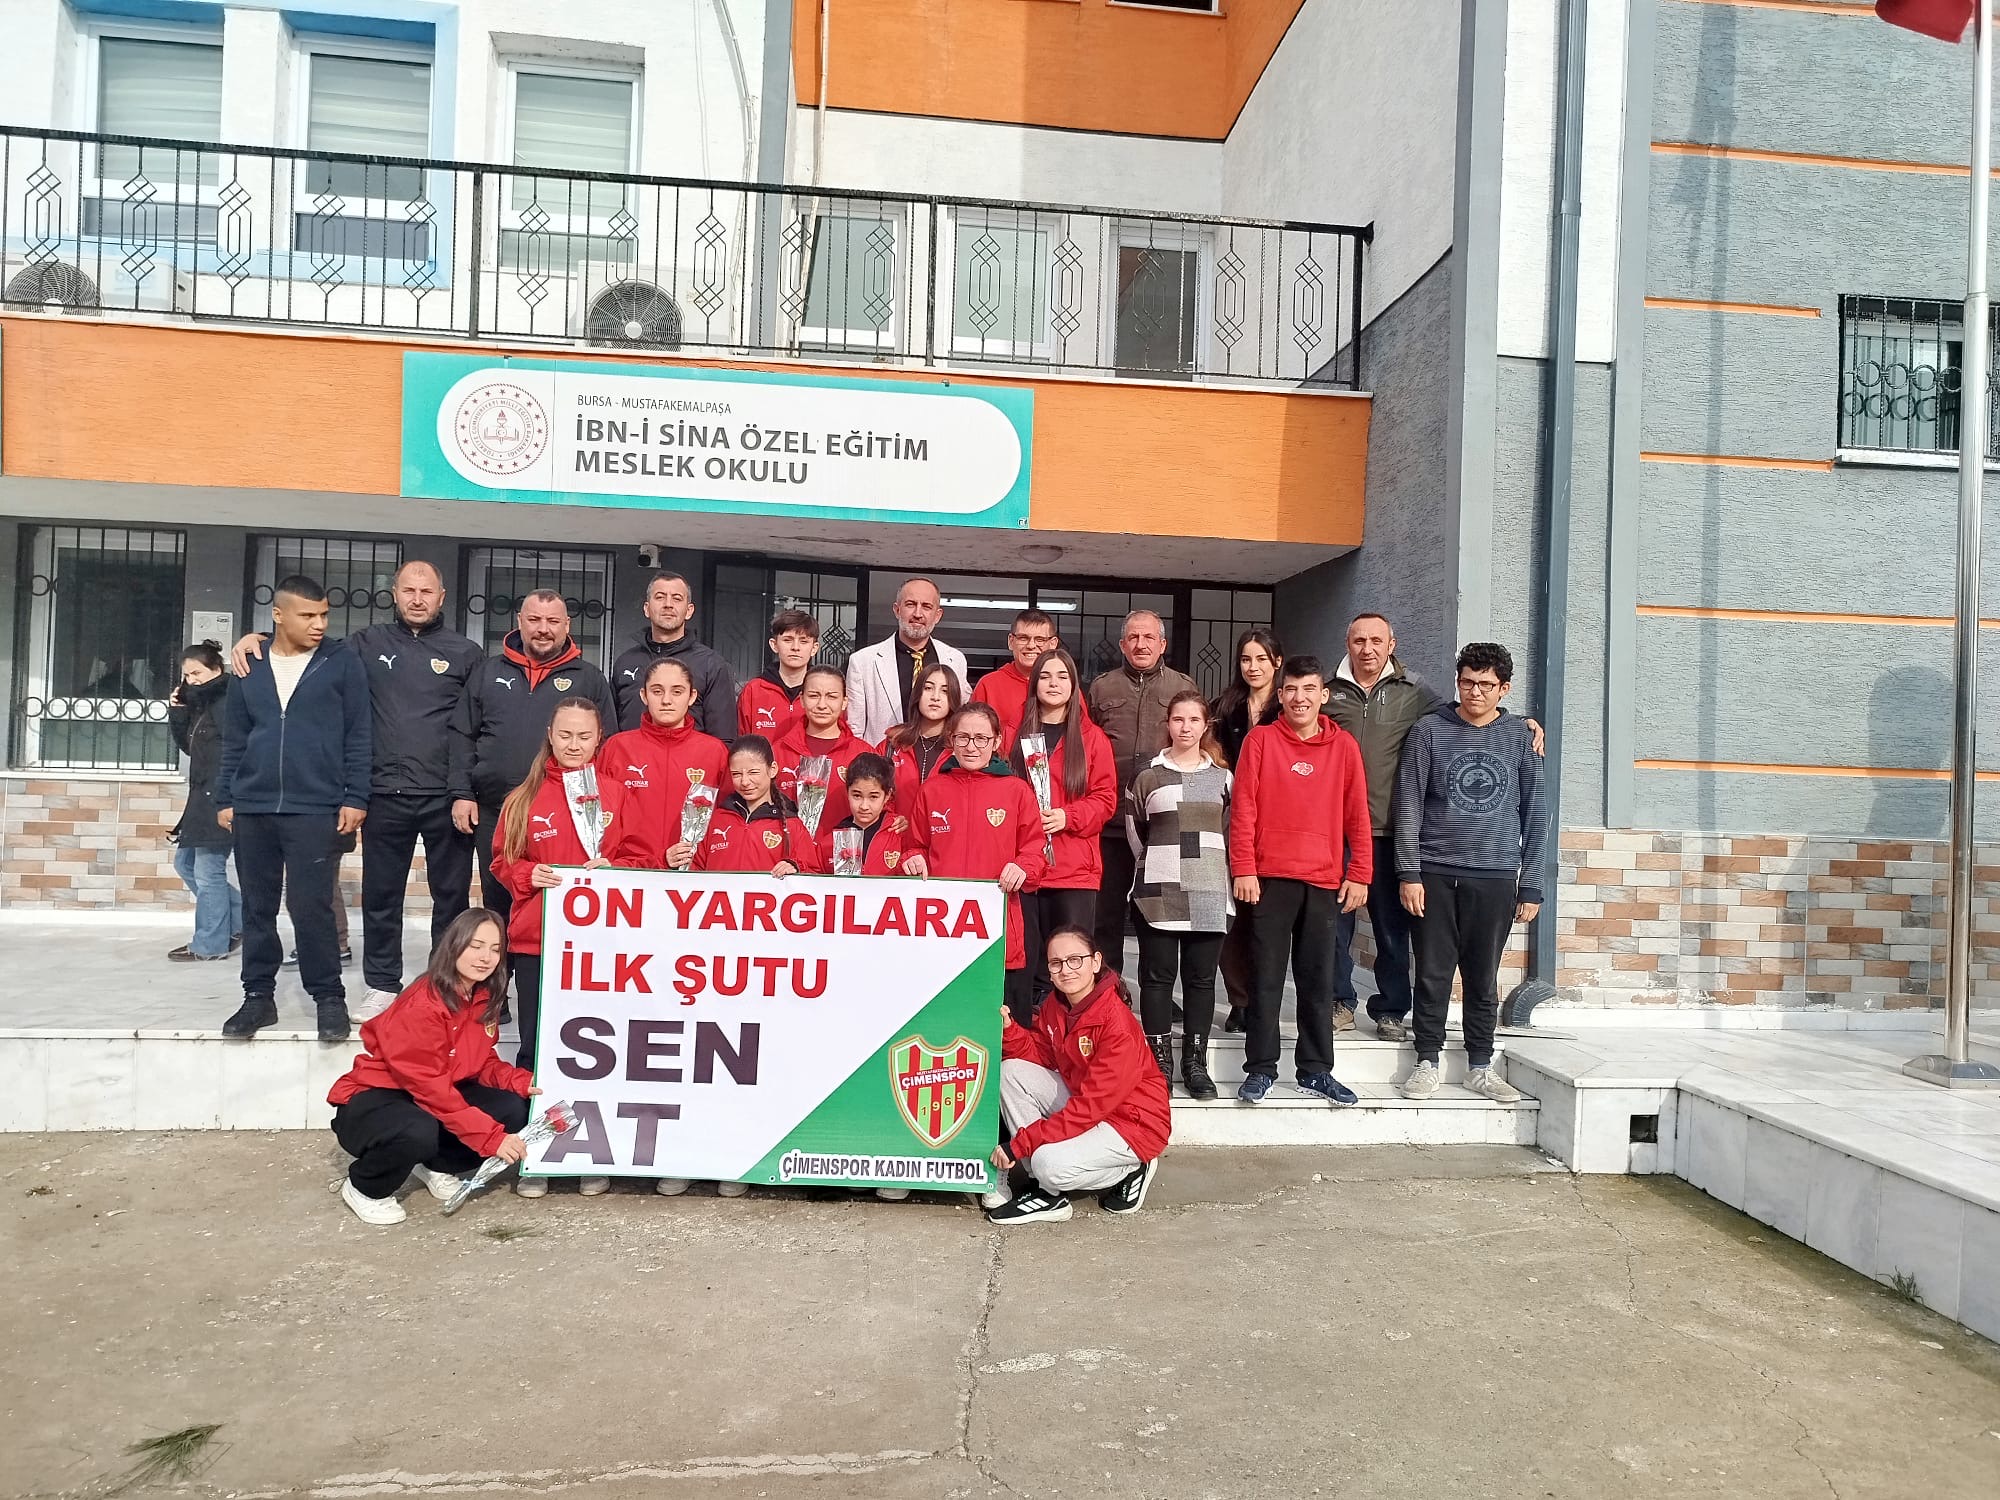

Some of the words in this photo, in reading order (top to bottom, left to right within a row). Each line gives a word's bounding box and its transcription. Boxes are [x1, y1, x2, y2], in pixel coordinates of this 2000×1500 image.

[577, 394, 612, 407] BURSA
[621, 397, 732, 417] MUSTAFAKEMALPAŞA
[576, 413, 649, 445] İBN-İ
[658, 419, 730, 449] SİNA
[740, 423, 817, 454] ÖZEL
[826, 429, 928, 461] EĞİTİM
[575, 450, 695, 478] MESLEK
[704, 457, 808, 484] OKULU
[562, 877, 644, 929] ÖN
[664, 889, 990, 940] YARGILARA
[560, 940, 654, 994] İLK
[672, 953, 829, 1006] ŞUTU
[556, 1016, 761, 1086] SEN
[541, 1100, 681, 1167] AT
[782, 1153, 870, 1178] ÇİMENSPOR
[875, 1159, 921, 1178] KADIN
[926, 1161, 984, 1180] FUTBOL
